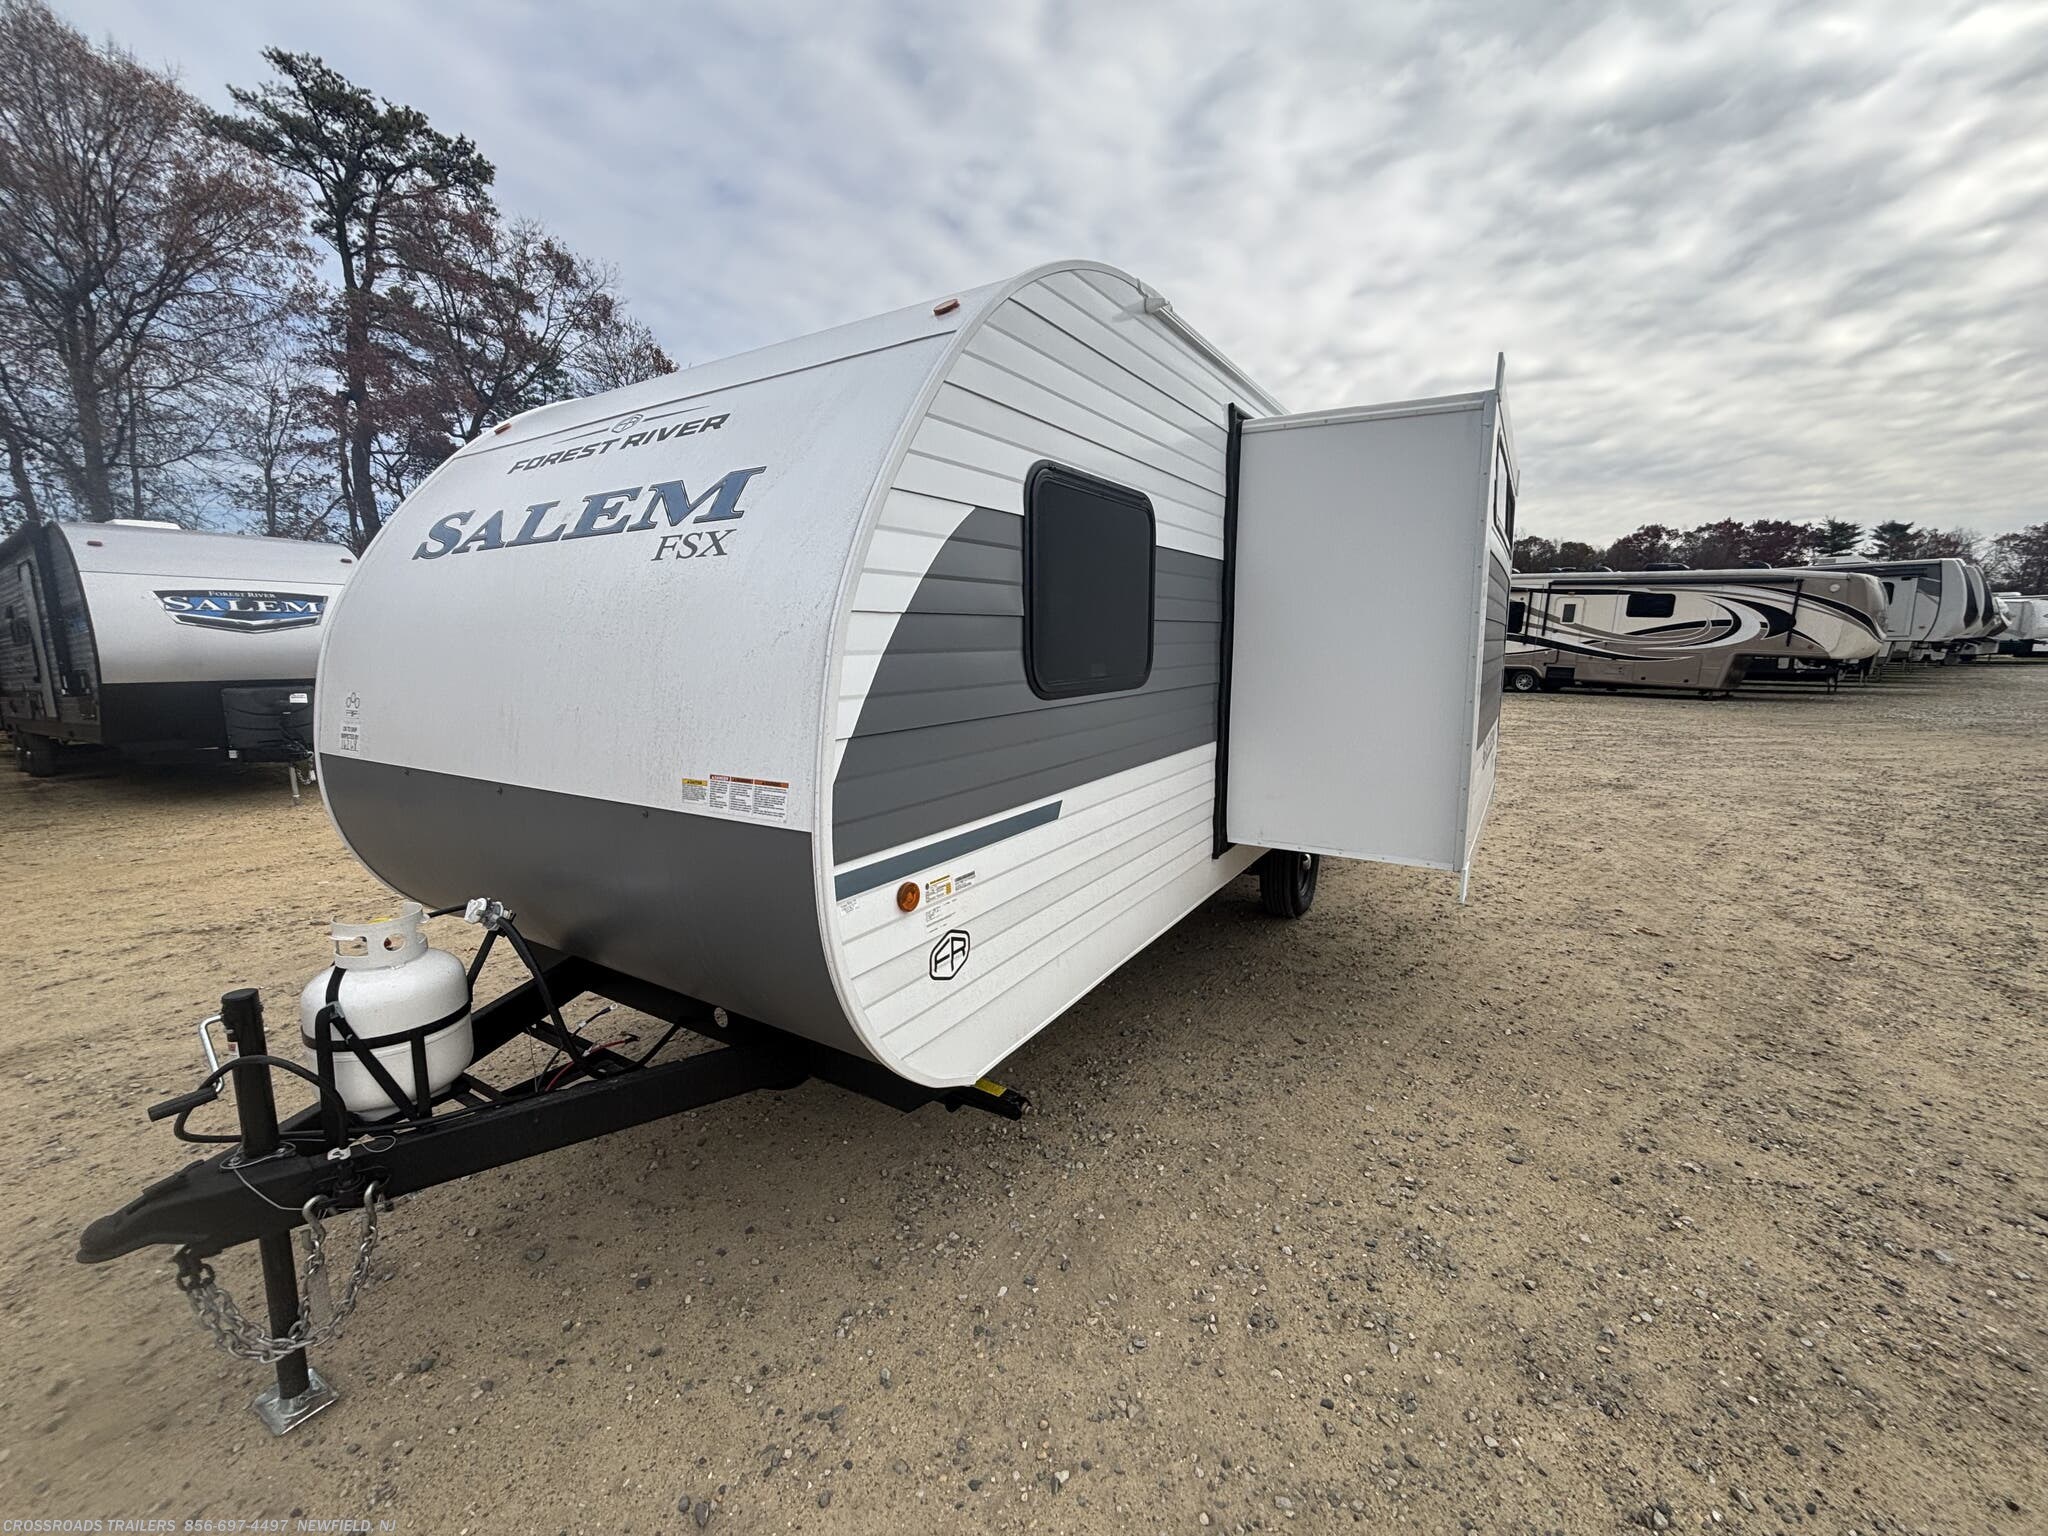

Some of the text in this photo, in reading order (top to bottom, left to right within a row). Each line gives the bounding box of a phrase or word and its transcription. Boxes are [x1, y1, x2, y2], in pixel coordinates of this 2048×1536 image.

[507, 438, 620, 474] FOREST
[619, 413, 731, 450] RIVER
[412, 466, 767, 560] SALEM
[651, 528, 737, 561] FSX
[163, 595, 320, 613] SALEM
[208, 590, 277, 599] FOREST RIVER
